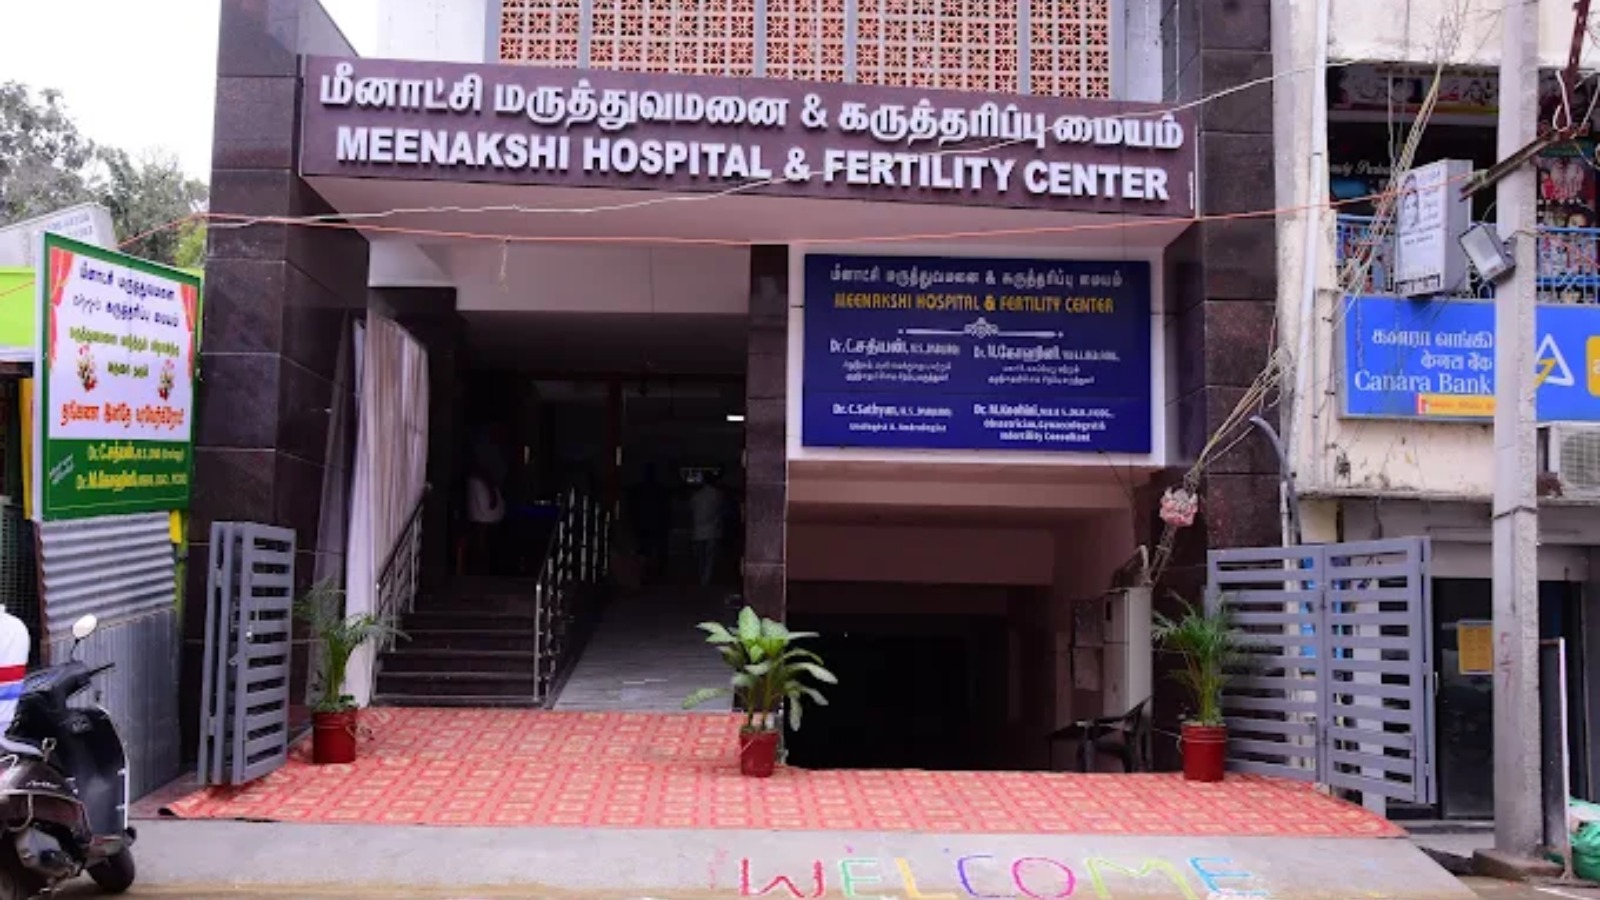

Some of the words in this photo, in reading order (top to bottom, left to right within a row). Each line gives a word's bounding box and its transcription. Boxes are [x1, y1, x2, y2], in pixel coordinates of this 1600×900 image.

[320, 62, 482, 111] மீனாட்சி
[495, 80, 789, 131] மருத்துவமனை
[800, 93, 828, 129] &
[839, 99, 1046, 149] கருத்தரிப்பு
[1054, 112, 1184, 150] மையம்
[336, 125, 570, 170] MEENAKSHI
[583, 137, 772, 179] HOSPITAL
[783, 146, 811, 182] &
[823, 149, 1014, 193] FERTILITY
[1024, 161, 1171, 201] CENTER
[830, 263, 881, 281] மீனாட்சி
[886, 265, 979, 289] மருத்துவமனை
[986, 270, 996, 285] &
[1002, 268, 1073, 289] கருத்தரிப்பு
[834, 293, 912, 309] MEENAKSHI
[916, 294, 980, 311] HOSPITAL
[984, 295, 996, 312] &
[1001, 296, 1062, 312] FERTILITY
[1065, 297, 1114, 314] CENTER
[1354, 370, 1431, 393] Canara
[1438, 372, 1493, 394] Bank
[738, 855, 1268, 898] WELCOME
